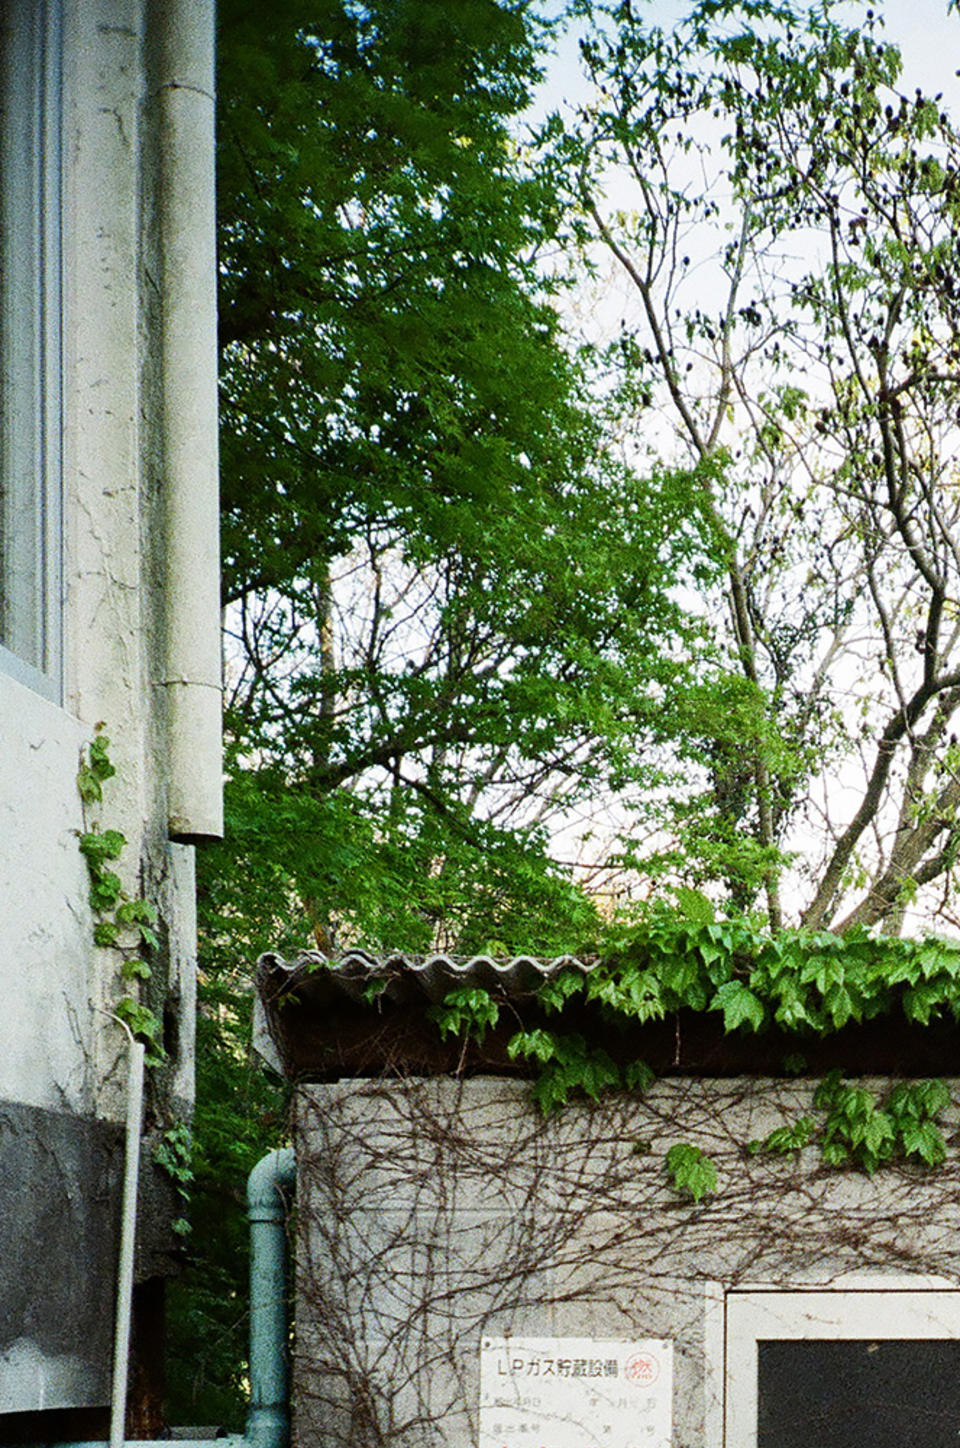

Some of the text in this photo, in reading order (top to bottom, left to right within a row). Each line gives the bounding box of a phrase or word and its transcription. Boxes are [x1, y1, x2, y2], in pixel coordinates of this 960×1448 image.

[497, 1359, 619, 1379] LPガス貯蔵設備
